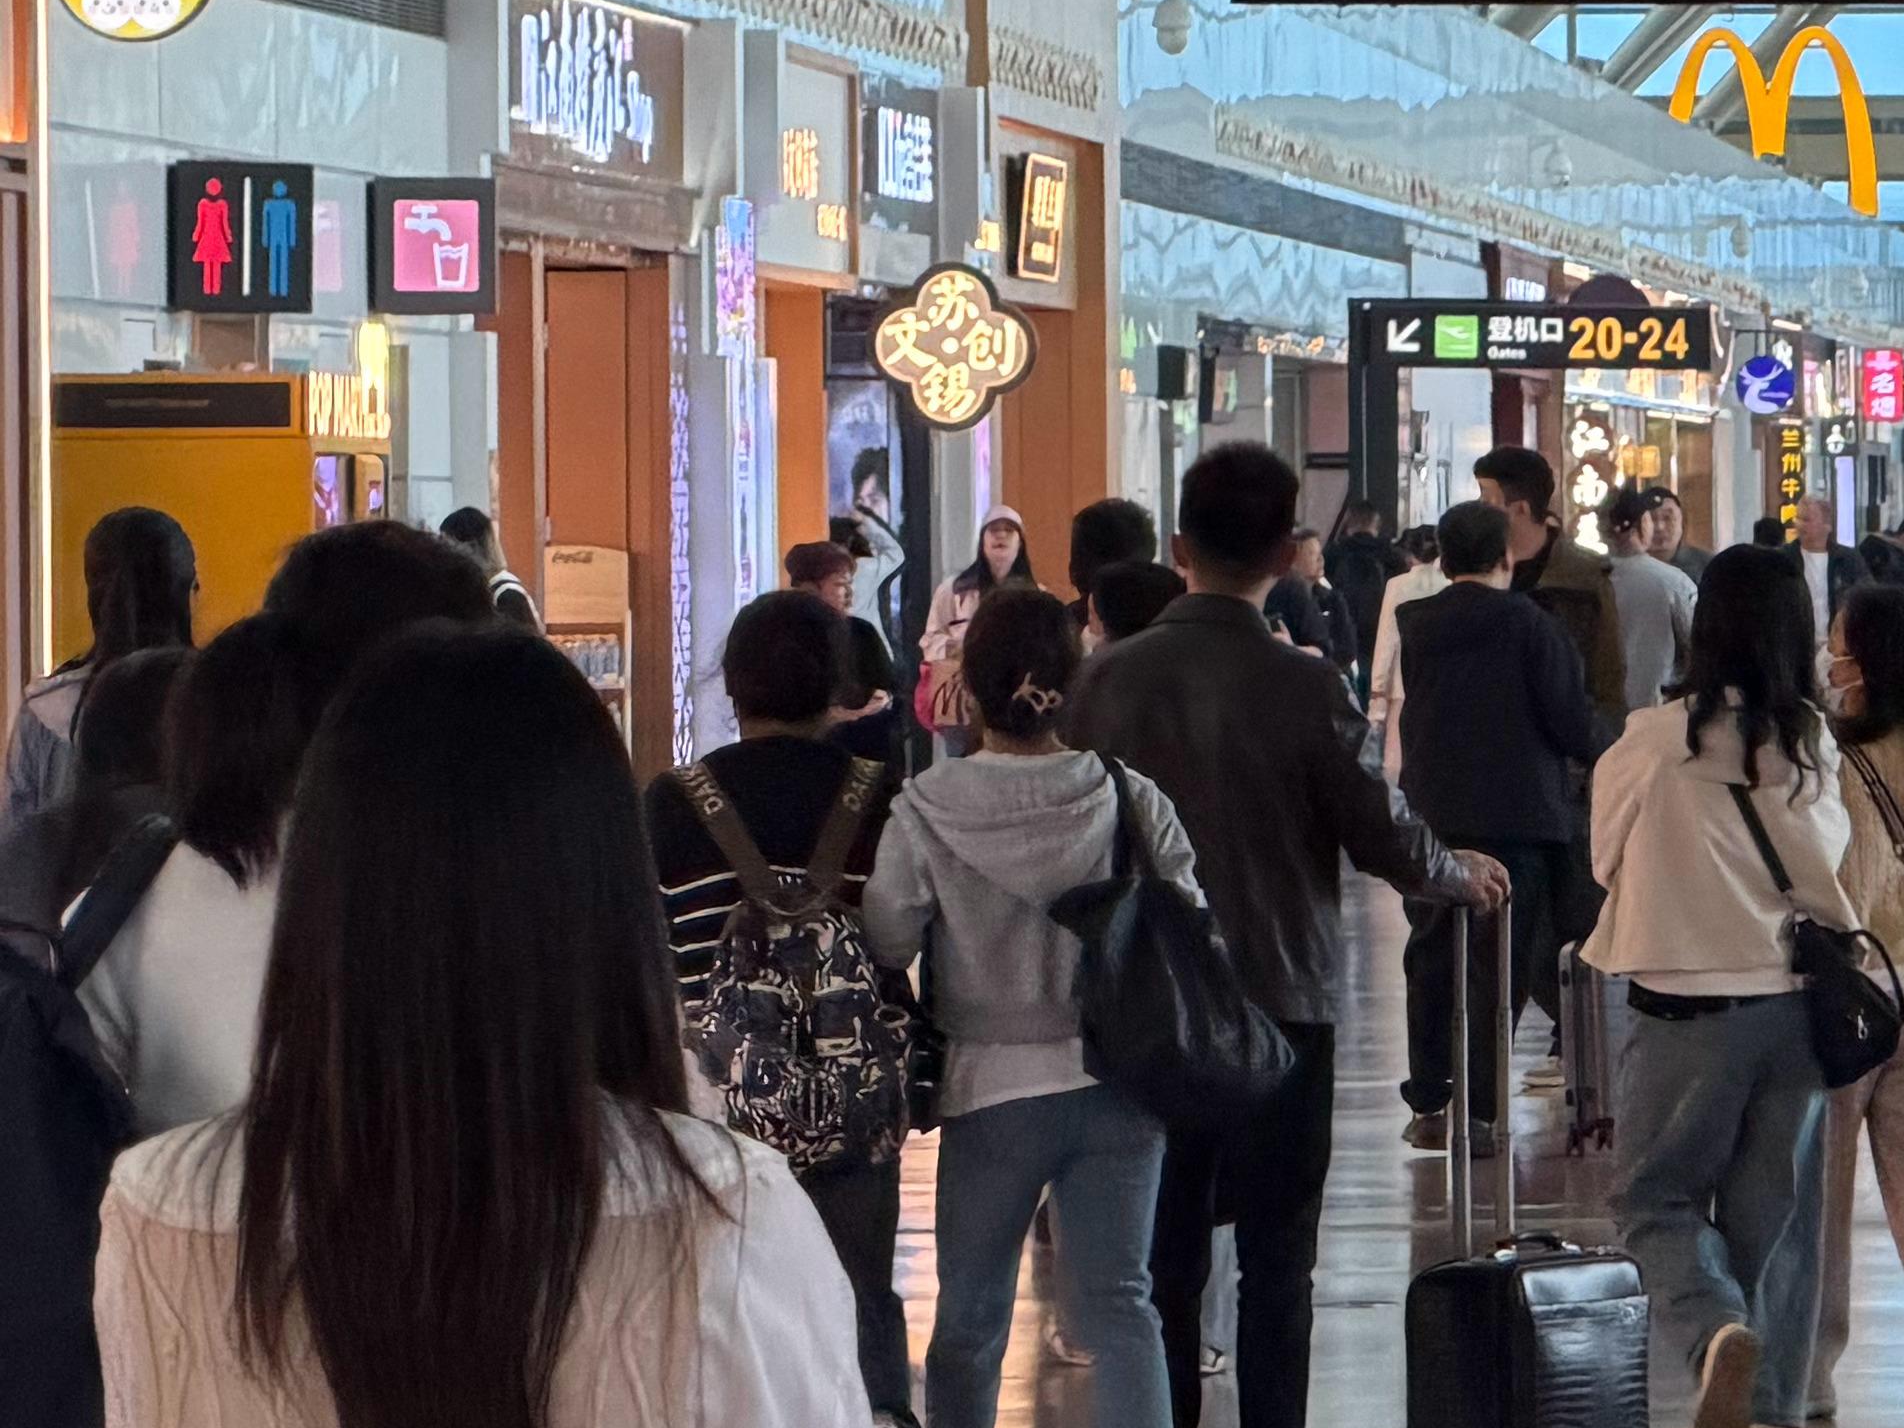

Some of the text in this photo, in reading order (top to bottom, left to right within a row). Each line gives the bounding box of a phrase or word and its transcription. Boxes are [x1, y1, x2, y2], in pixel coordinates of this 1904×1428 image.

[1487, 316, 1565, 344] 登机口
[1567, 316, 1690, 361] 20-24
